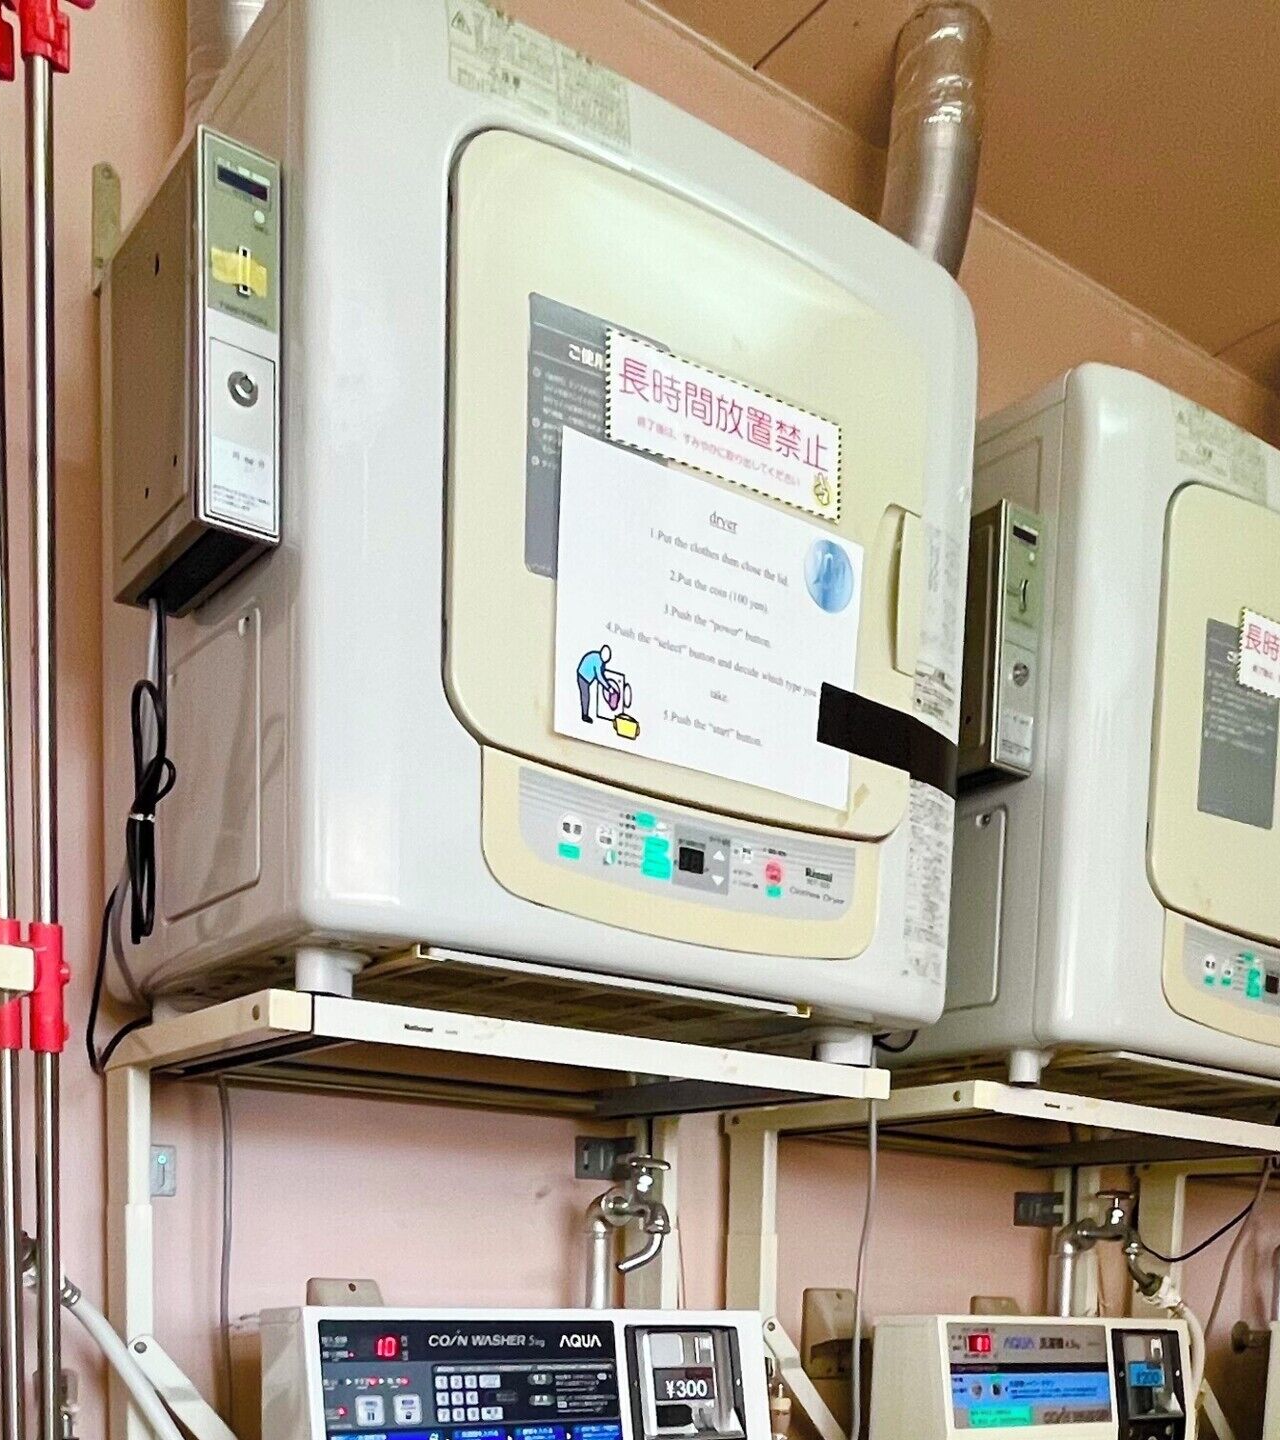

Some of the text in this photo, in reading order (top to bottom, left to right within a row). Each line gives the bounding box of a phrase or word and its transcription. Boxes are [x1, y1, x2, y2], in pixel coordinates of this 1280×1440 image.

[619, 357, 829, 472] 長時間放置禁止
[709, 510, 739, 534] dryer
[674, 536, 689, 549] the
[376, 1335, 397, 1358] 10
[471, 1335, 526, 1346] WASHER
[559, 1334, 603, 1348] AQUA
[665, 1379, 708, 1399] ¥300
